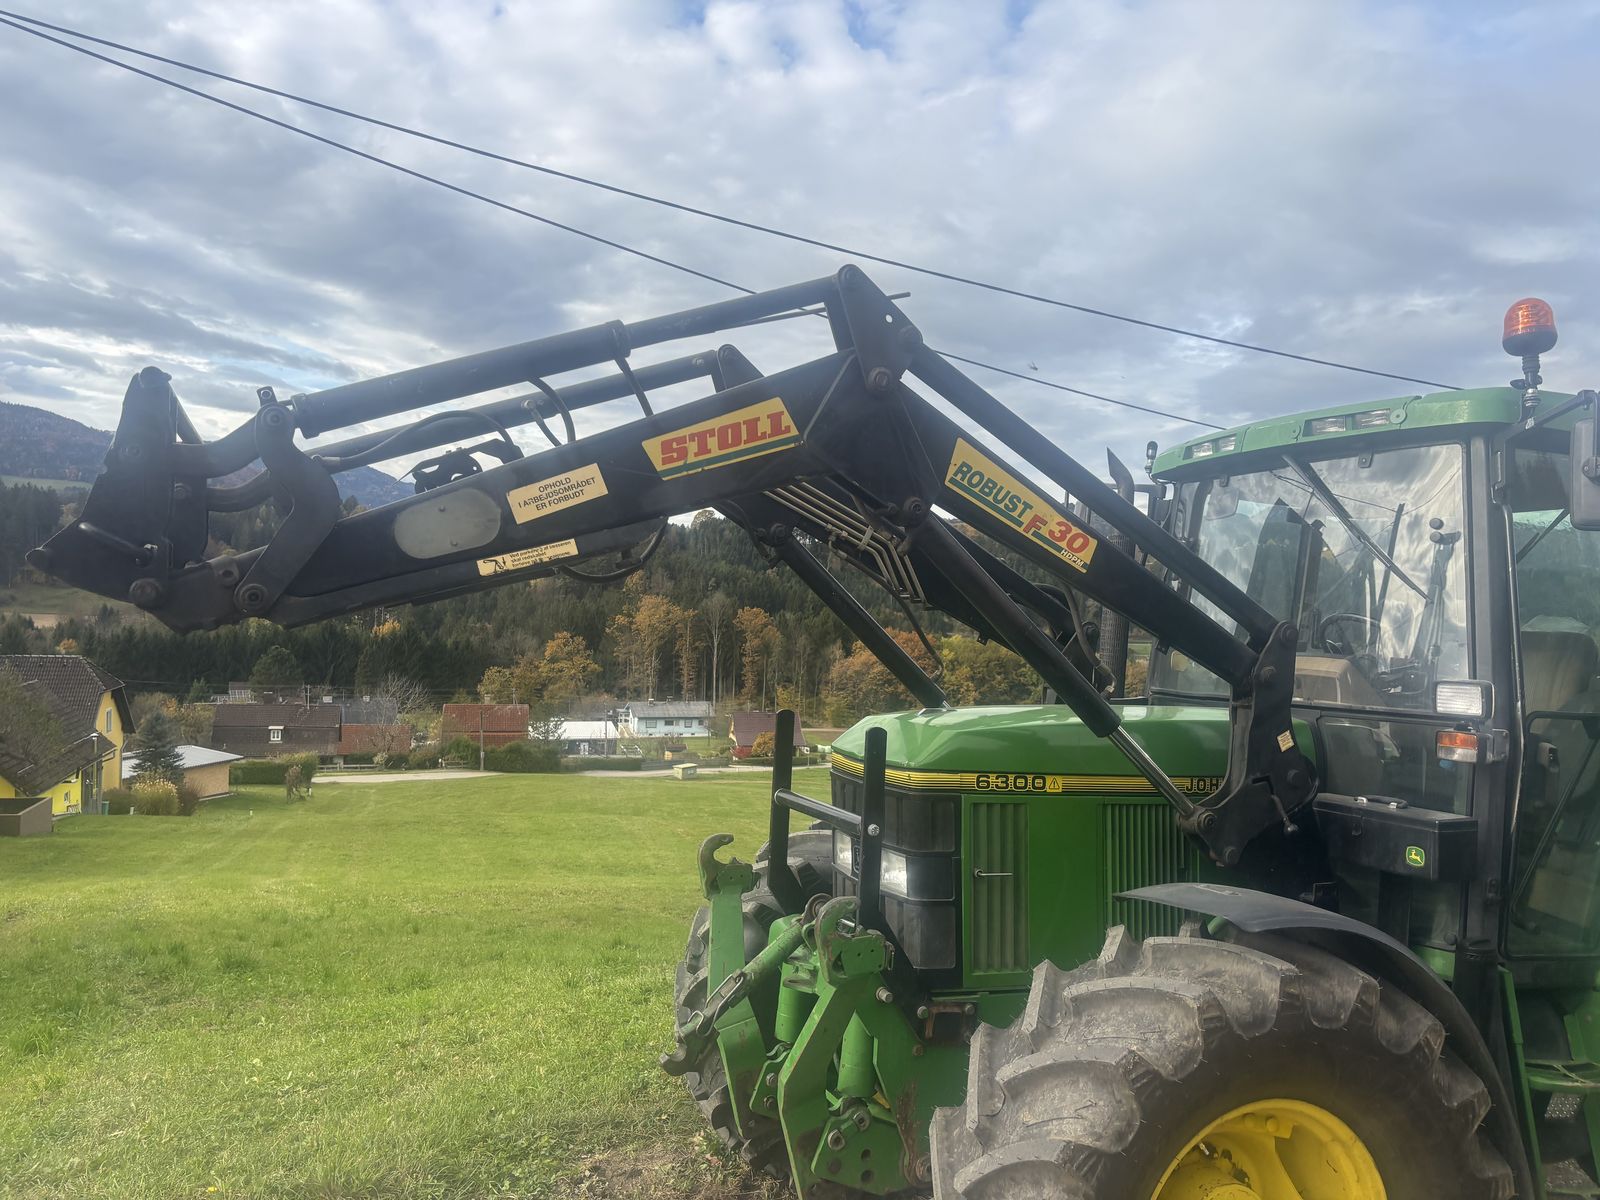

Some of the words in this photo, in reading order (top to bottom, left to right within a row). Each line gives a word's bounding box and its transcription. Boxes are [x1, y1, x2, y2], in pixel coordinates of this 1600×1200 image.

[660, 411, 791, 466] STOLL
[523, 477, 596, 508] ARBEJDSOMRÅDET
[538, 477, 571, 493] OPHOLD
[535, 502, 548, 511] ER
[548, 489, 585, 507] FORBUDT
[953, 461, 1034, 519] ROBUST
[1022, 514, 1049, 534] F
[1047, 520, 1090, 554] 30
[1060, 549, 1084, 567] HDPM
[975, 774, 1047, 791] 6300
[1185, 777, 1222, 793] JOH
